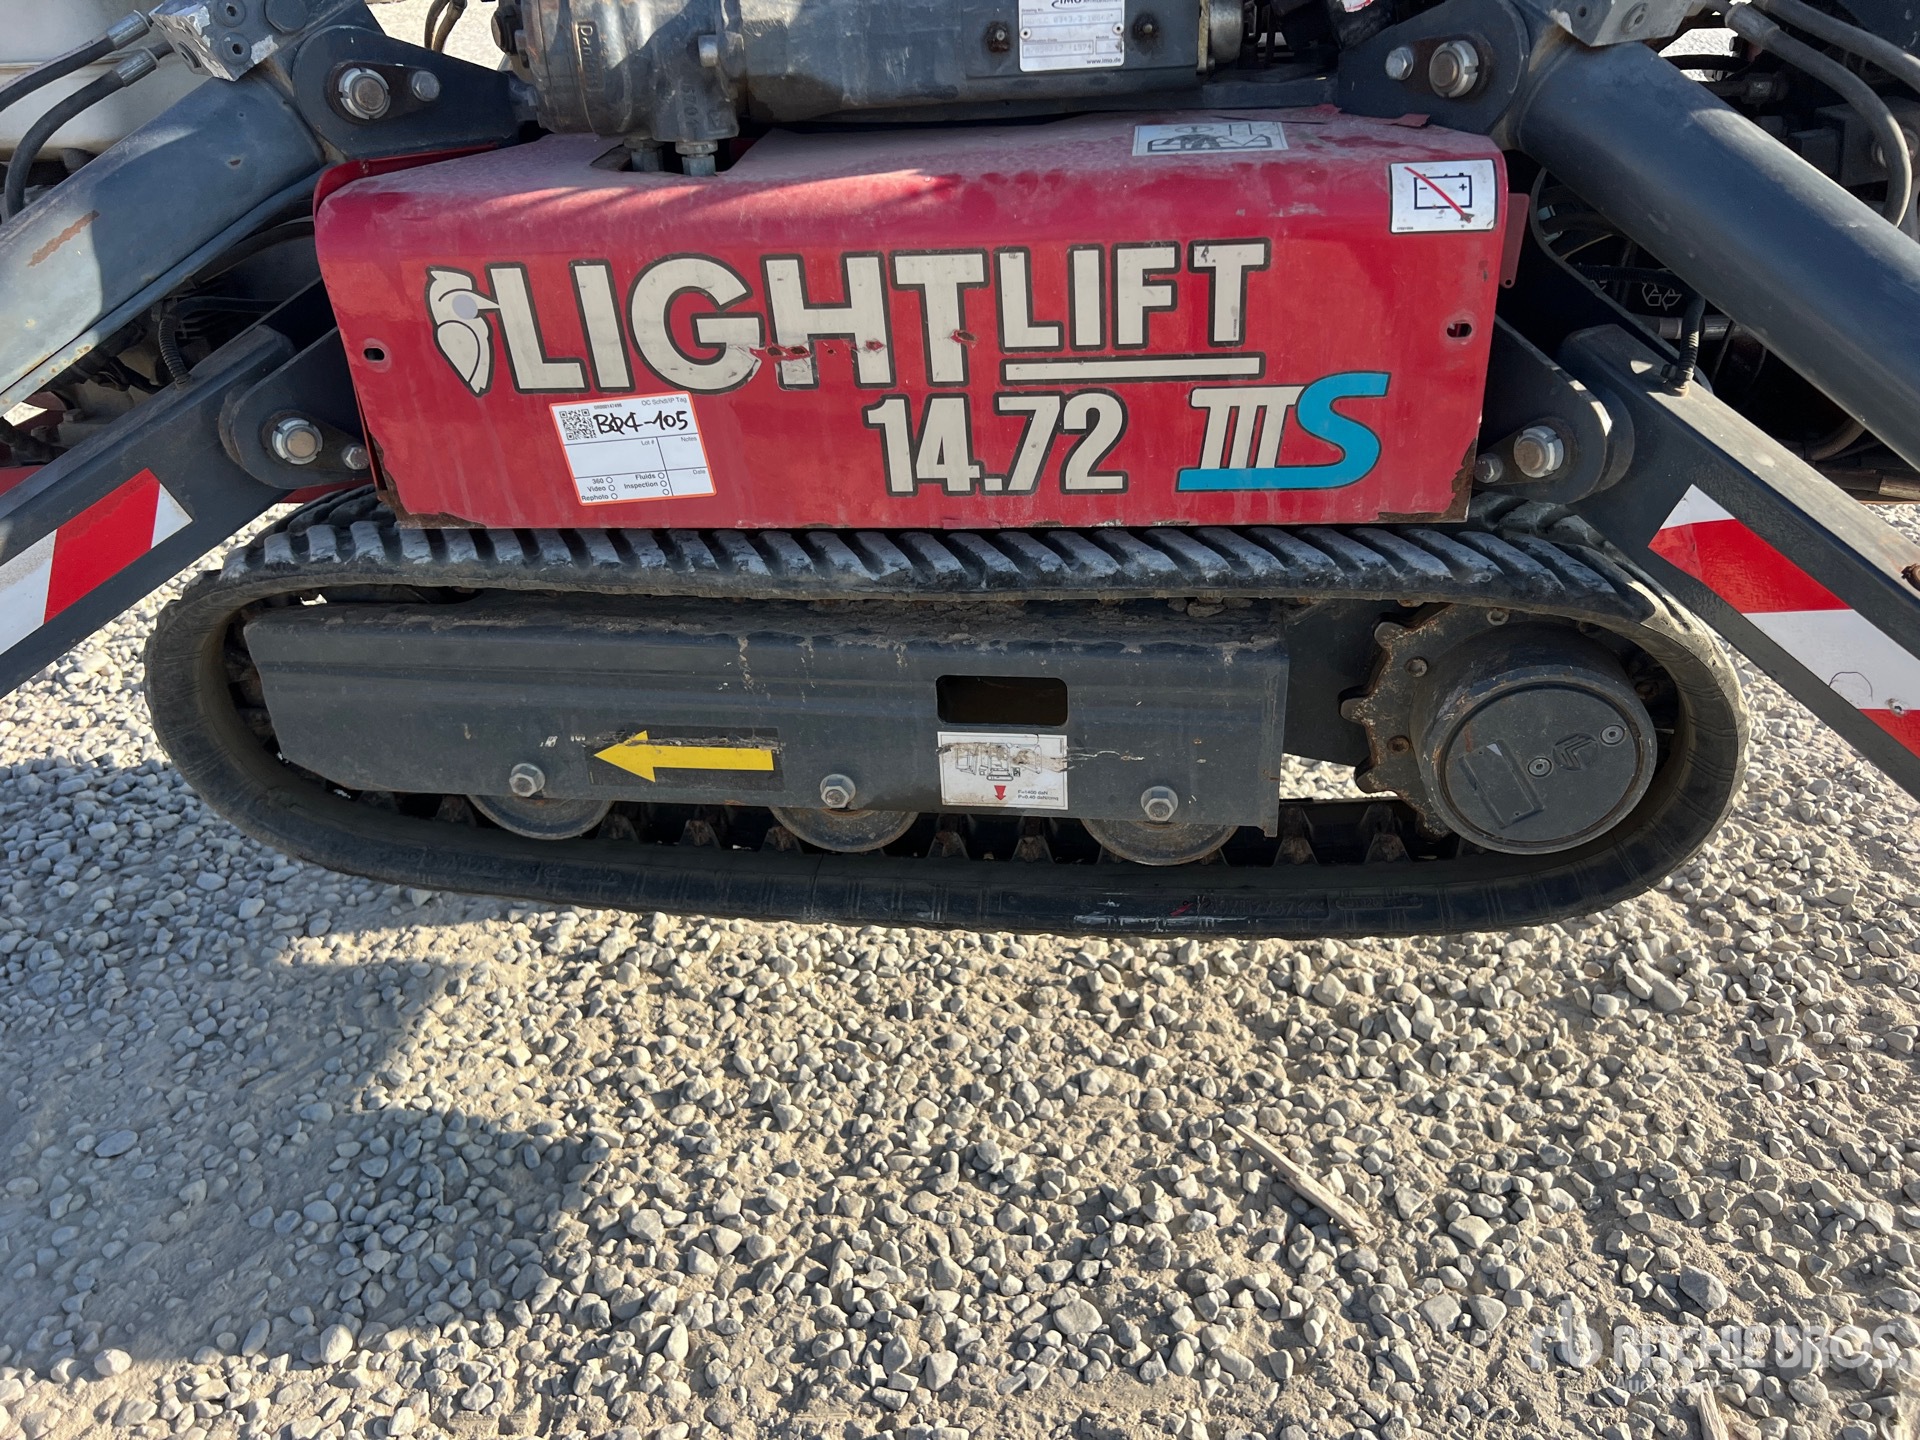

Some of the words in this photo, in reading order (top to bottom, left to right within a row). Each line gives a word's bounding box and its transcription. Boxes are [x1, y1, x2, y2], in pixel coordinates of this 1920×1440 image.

[866, 391, 1129, 494] 14.72
[623, 482, 659, 490] Inspection
[581, 494, 609, 502] Rephoto
